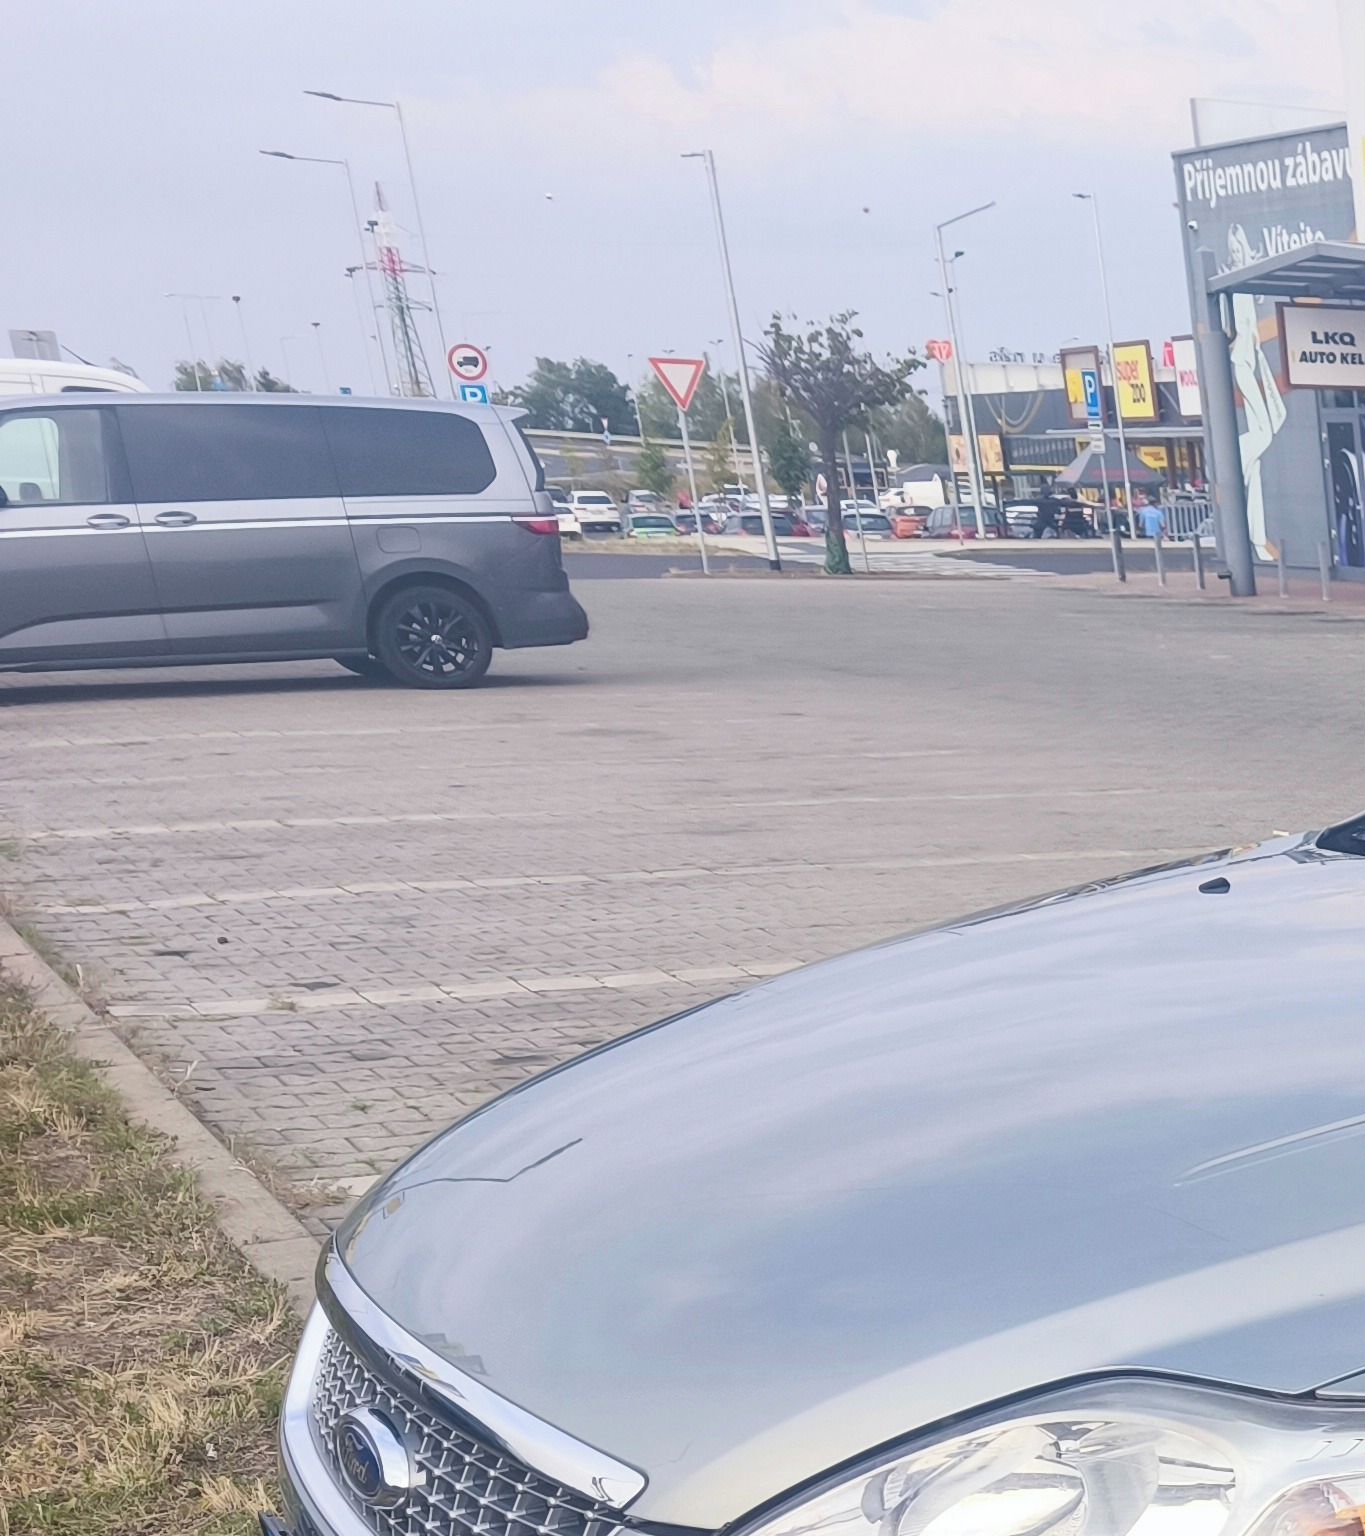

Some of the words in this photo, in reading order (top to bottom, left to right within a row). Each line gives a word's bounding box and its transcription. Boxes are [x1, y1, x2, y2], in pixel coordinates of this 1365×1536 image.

[1183, 156, 1283, 208] Příjemnou
[1311, 330, 1357, 347] LKQ
[1299, 350, 1337, 364] AUTO
